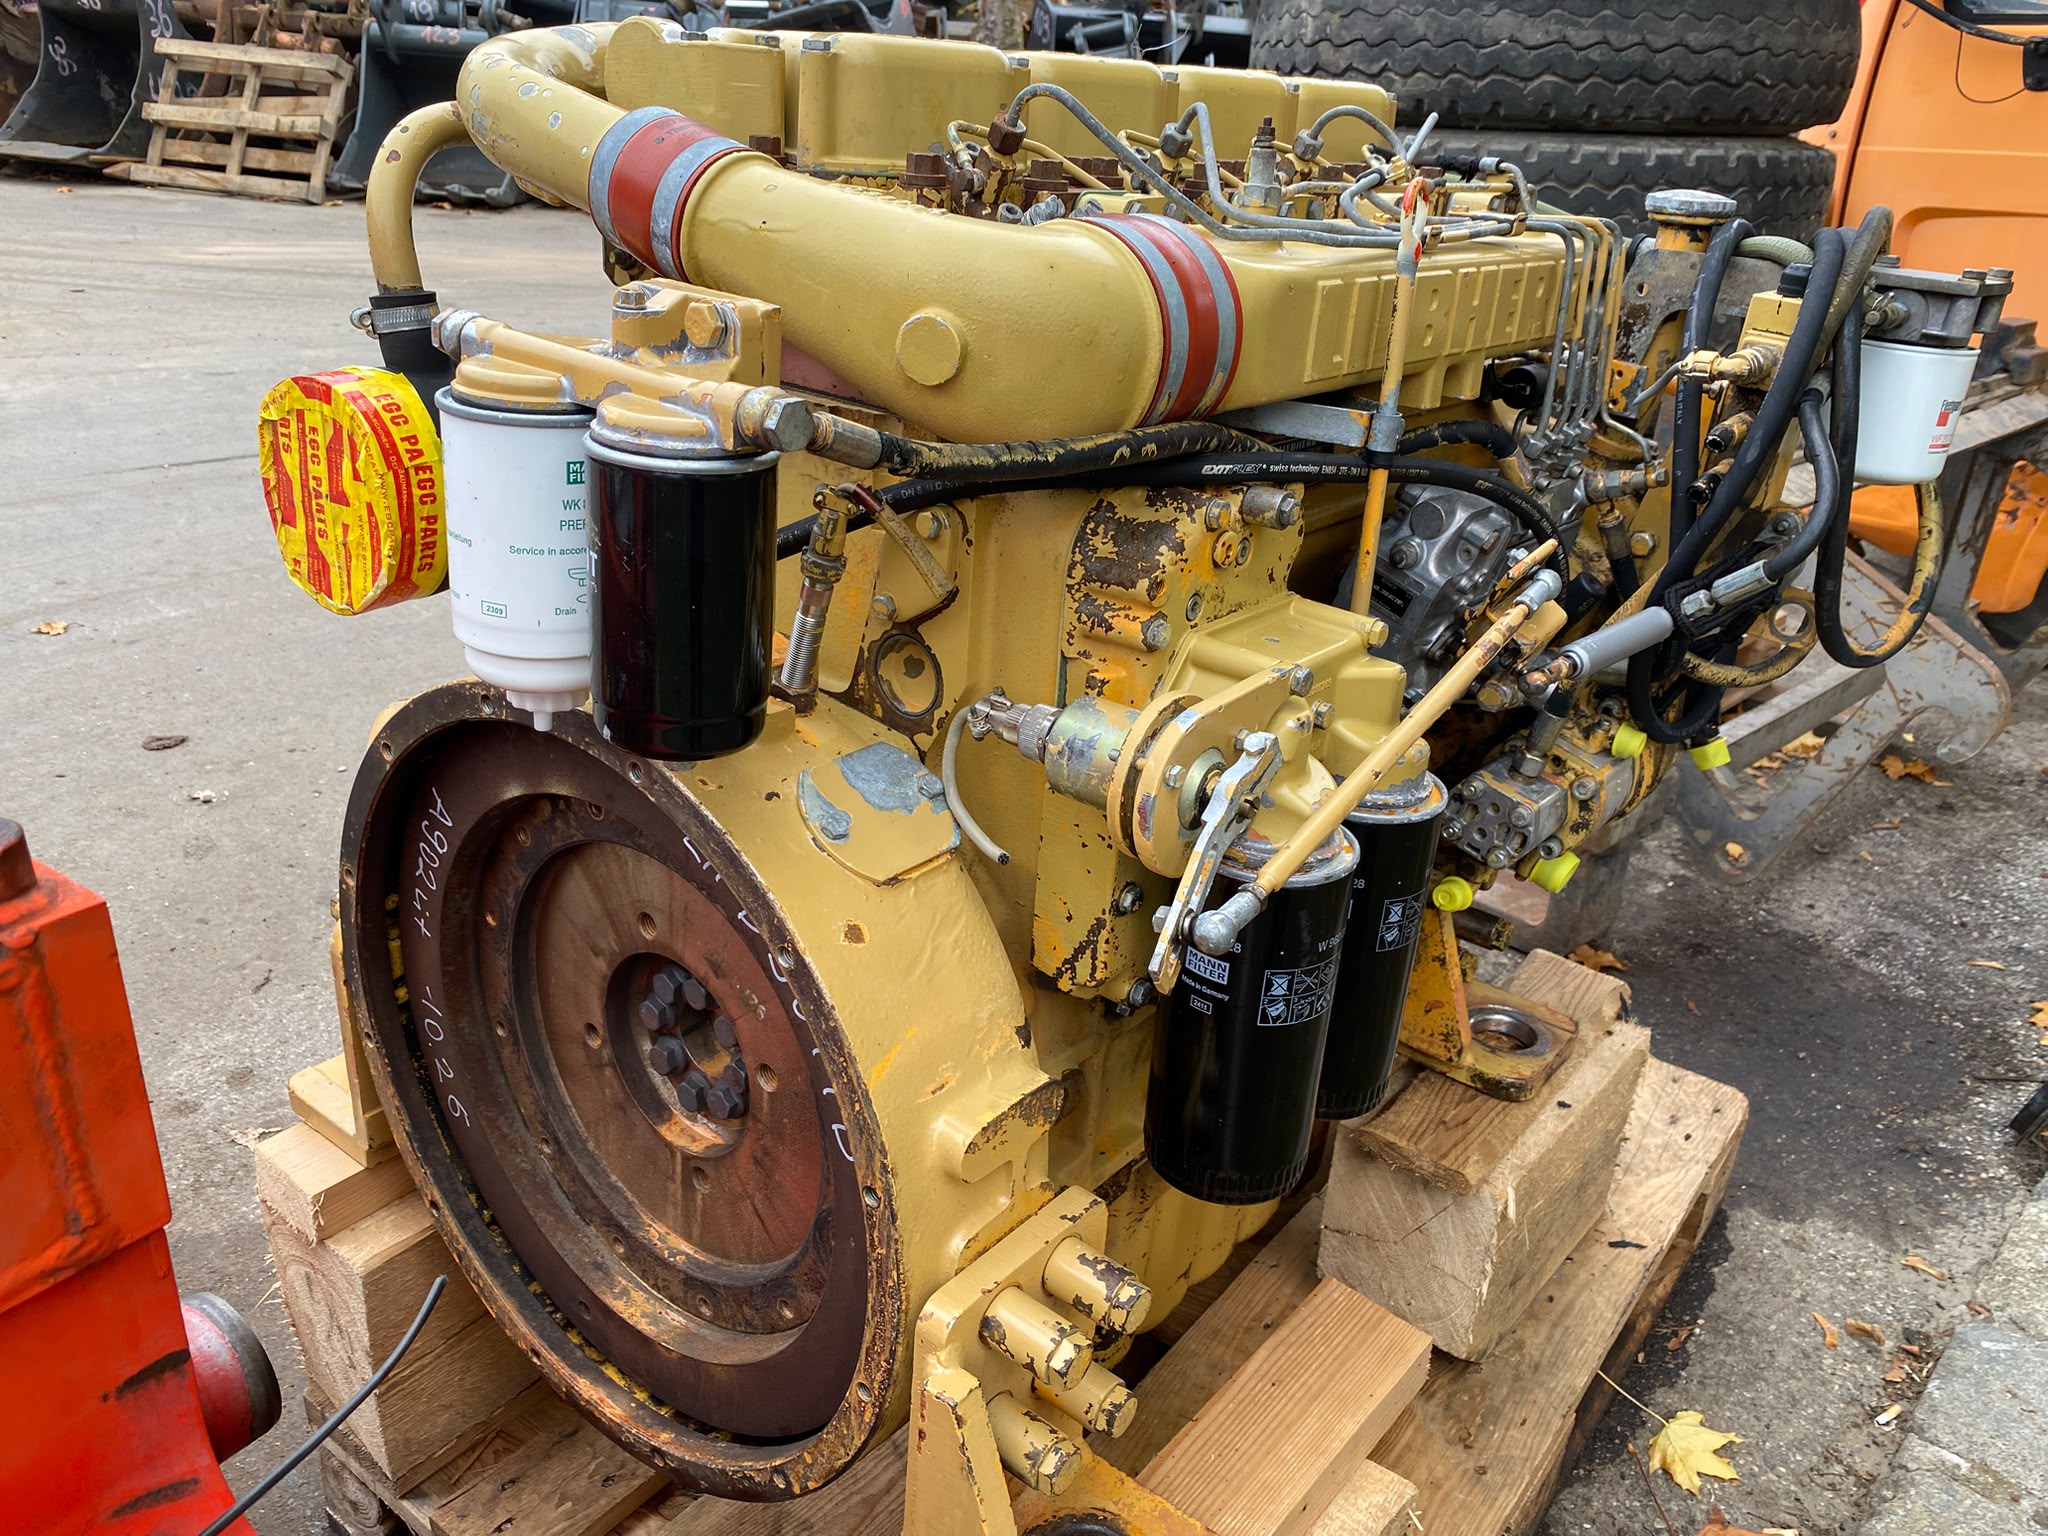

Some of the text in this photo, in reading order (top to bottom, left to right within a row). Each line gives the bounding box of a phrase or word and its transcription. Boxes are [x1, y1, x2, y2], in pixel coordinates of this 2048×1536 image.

[421, 26, 462, 46] 123
[278, 416, 293, 456] RTS
[373, 393, 425, 464] EGC PA
[307, 425, 322, 467] EGC
[1269, 463, 1289, 473] swiss
[1289, 463, 1320, 475] technology
[562, 500, 581, 510] WK
[413, 464, 439, 573] EGC PARTS
[509, 545, 545, 556] Service
[547, 546, 557, 556] in
[486, 604, 503, 616] 2309
[555, 606, 577, 616] Drain
[1187, 958, 1227, 983] FILTER
[1188, 949, 1228, 973] MANN
[1182, 973, 1196, 988] Made
[1201, 984, 1230, 1002] Germany
